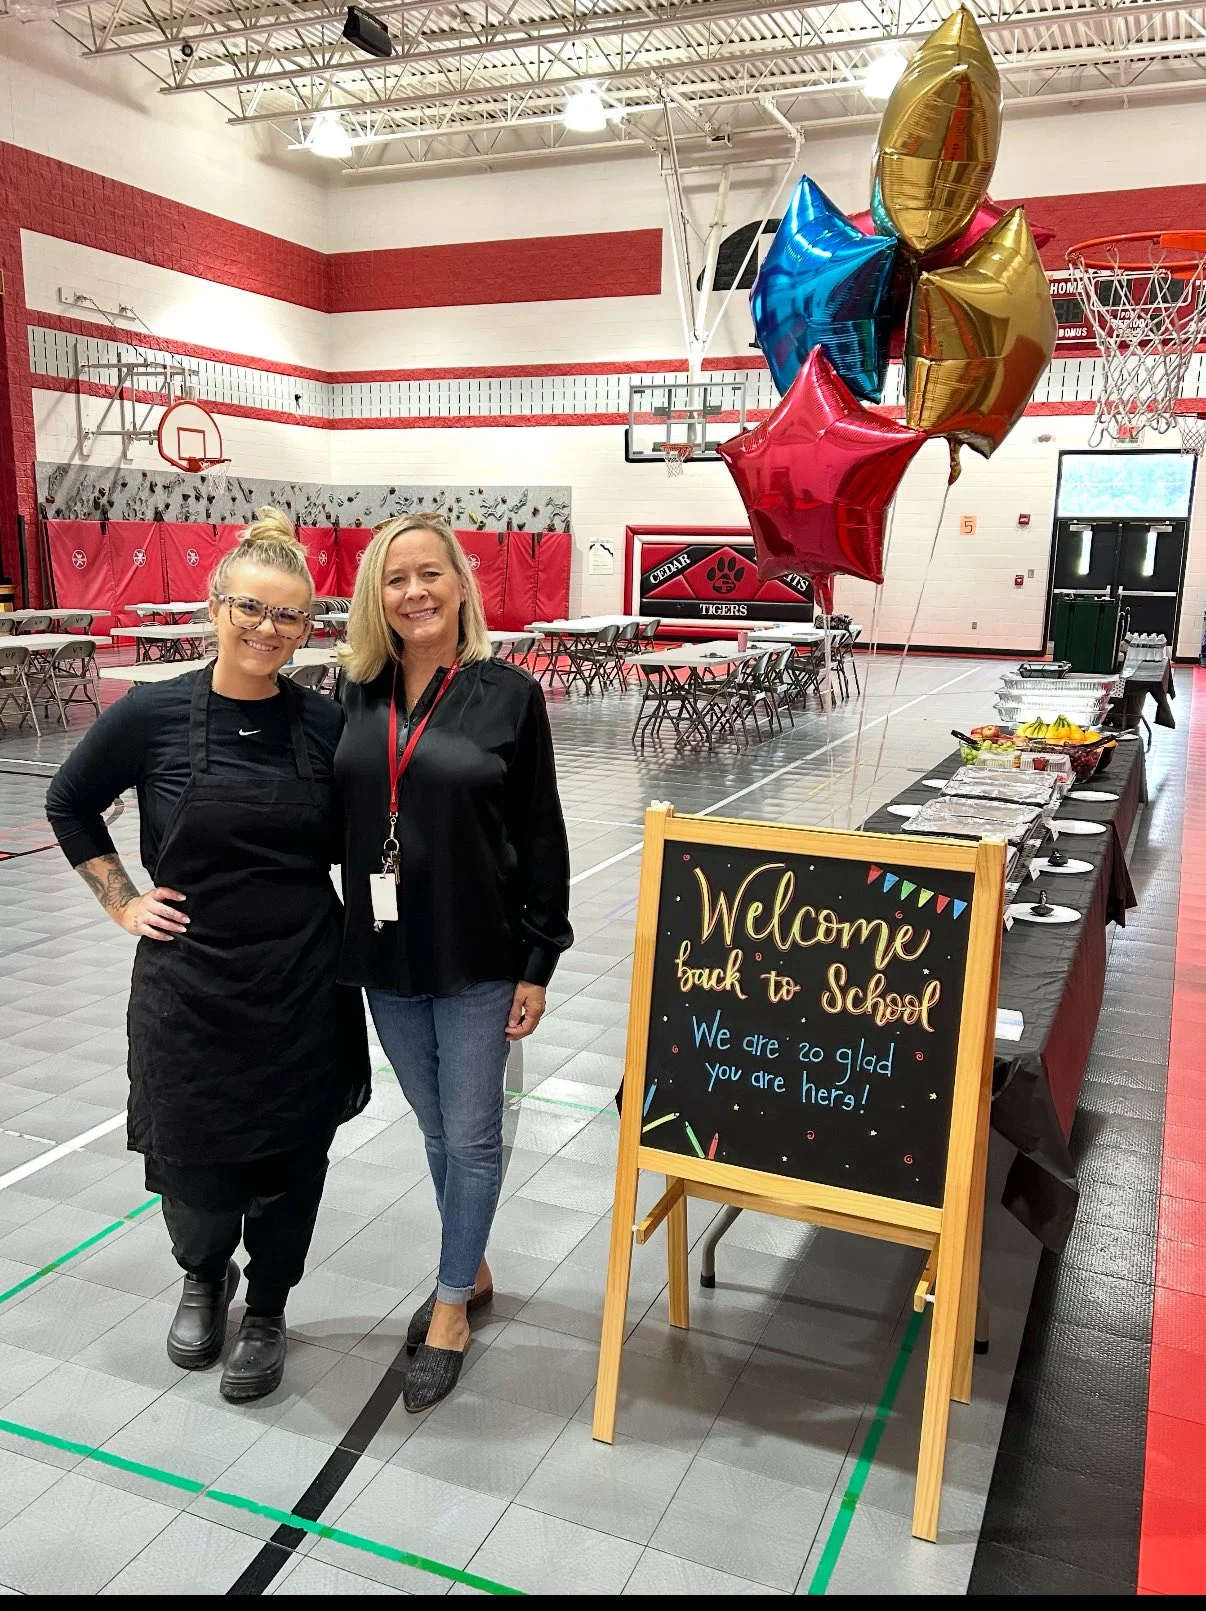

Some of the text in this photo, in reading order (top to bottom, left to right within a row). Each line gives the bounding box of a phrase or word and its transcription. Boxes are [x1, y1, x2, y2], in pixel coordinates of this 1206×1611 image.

[1050, 281, 1084, 295] HOME
[1058, 327, 1087, 338] BONUS
[964, 520, 973, 534] 5
[650, 553, 691, 584] CEDAR
[699, 604, 748, 617] TIGERS
[693, 862, 931, 970] Welcome
[674, 940, 941, 1033] back to School
[692, 1009, 731, 1050] We
[742, 1034, 779, 1059] are
[836, 1038, 895, 1085] glad
[705, 1062, 742, 1092] you
[751, 1071, 786, 1093] are
